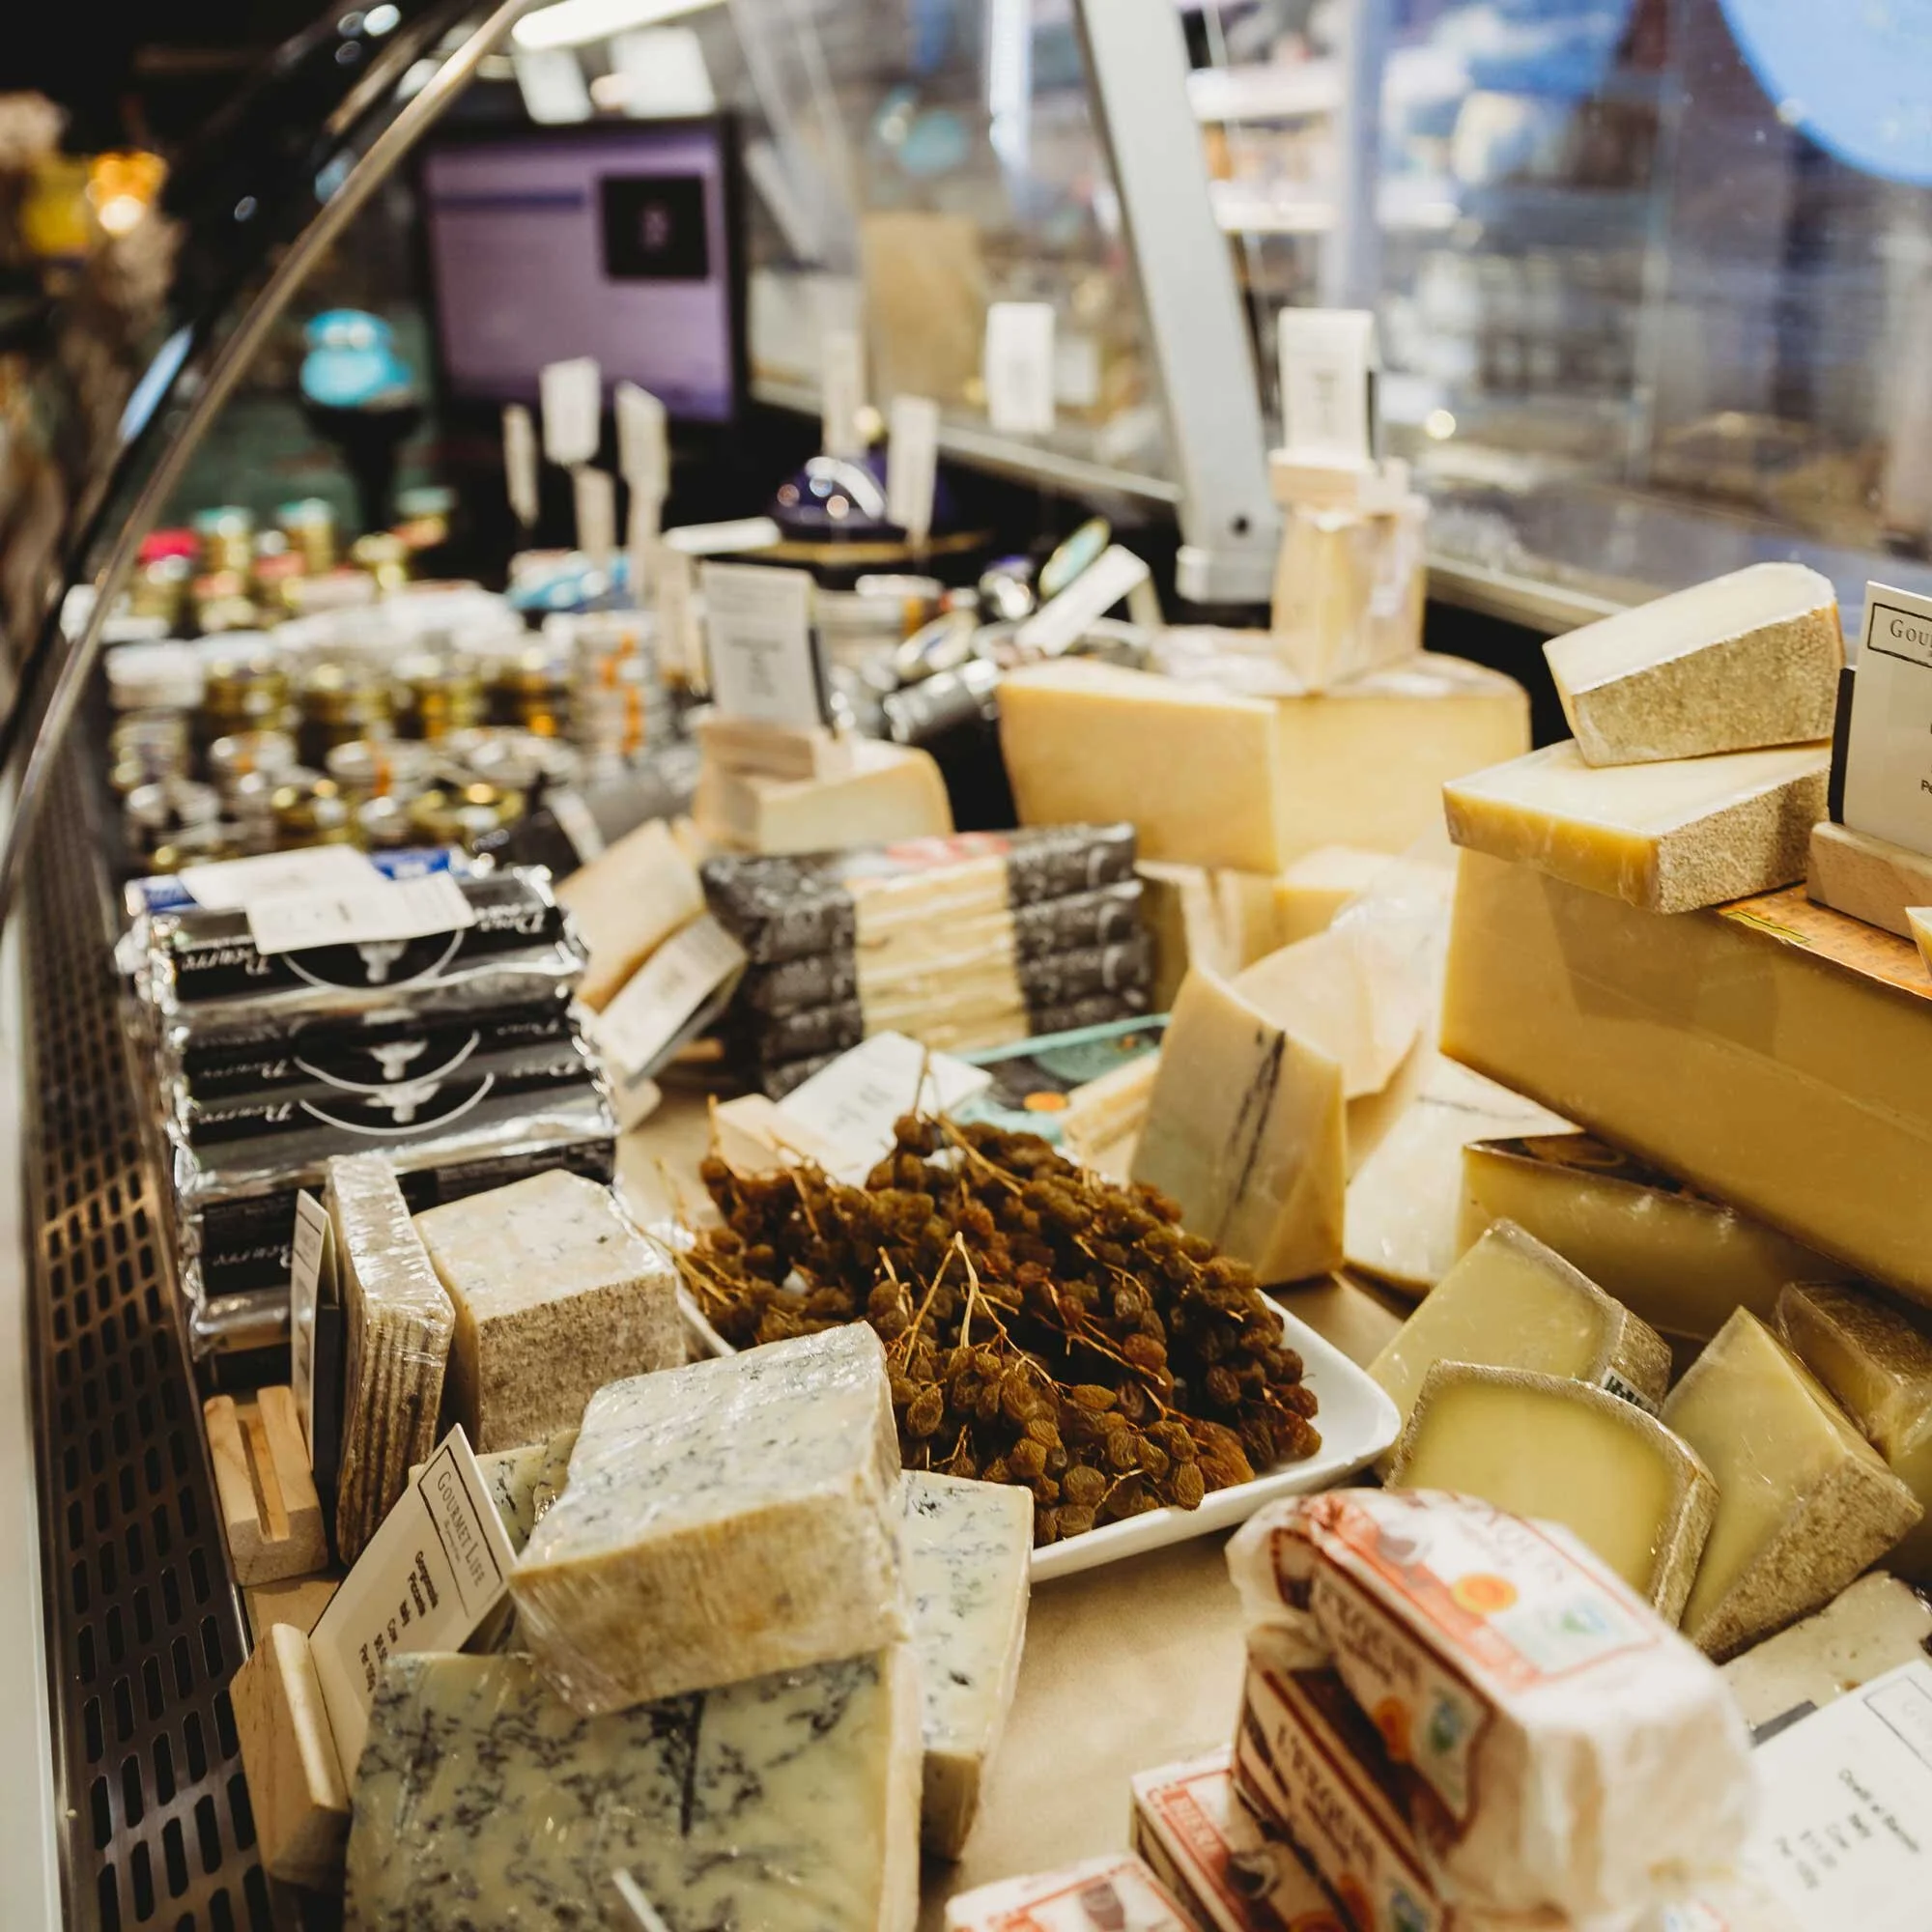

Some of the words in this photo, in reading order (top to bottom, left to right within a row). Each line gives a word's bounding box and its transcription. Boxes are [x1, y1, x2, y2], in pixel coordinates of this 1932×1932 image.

[1889, 618, 1932, 650] GOU
[438, 1470, 472, 1548] GOURMET
[465, 1542, 485, 1587] LIFE
